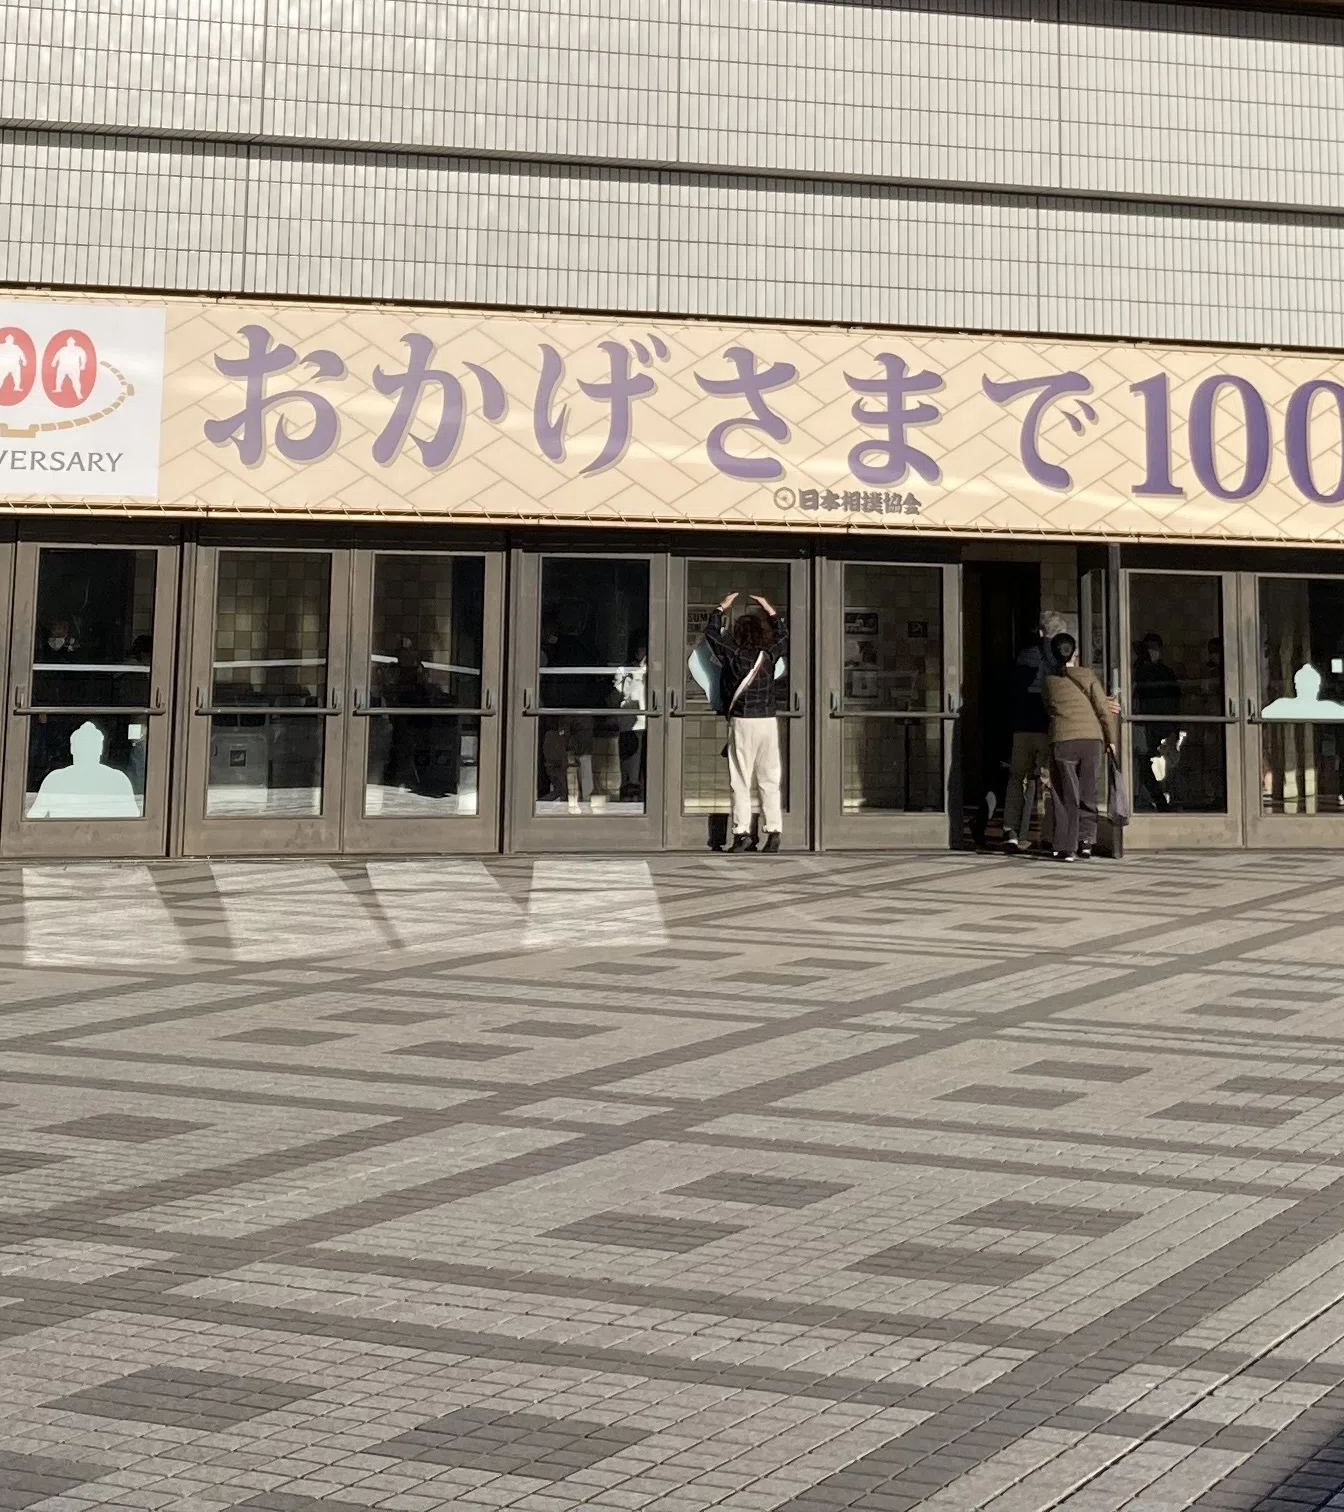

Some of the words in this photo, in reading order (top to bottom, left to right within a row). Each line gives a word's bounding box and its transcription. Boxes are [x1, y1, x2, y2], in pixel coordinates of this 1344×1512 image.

[798, 488, 922, 515] 日本相撲協会
[687, 612, 709, 622] SUM
